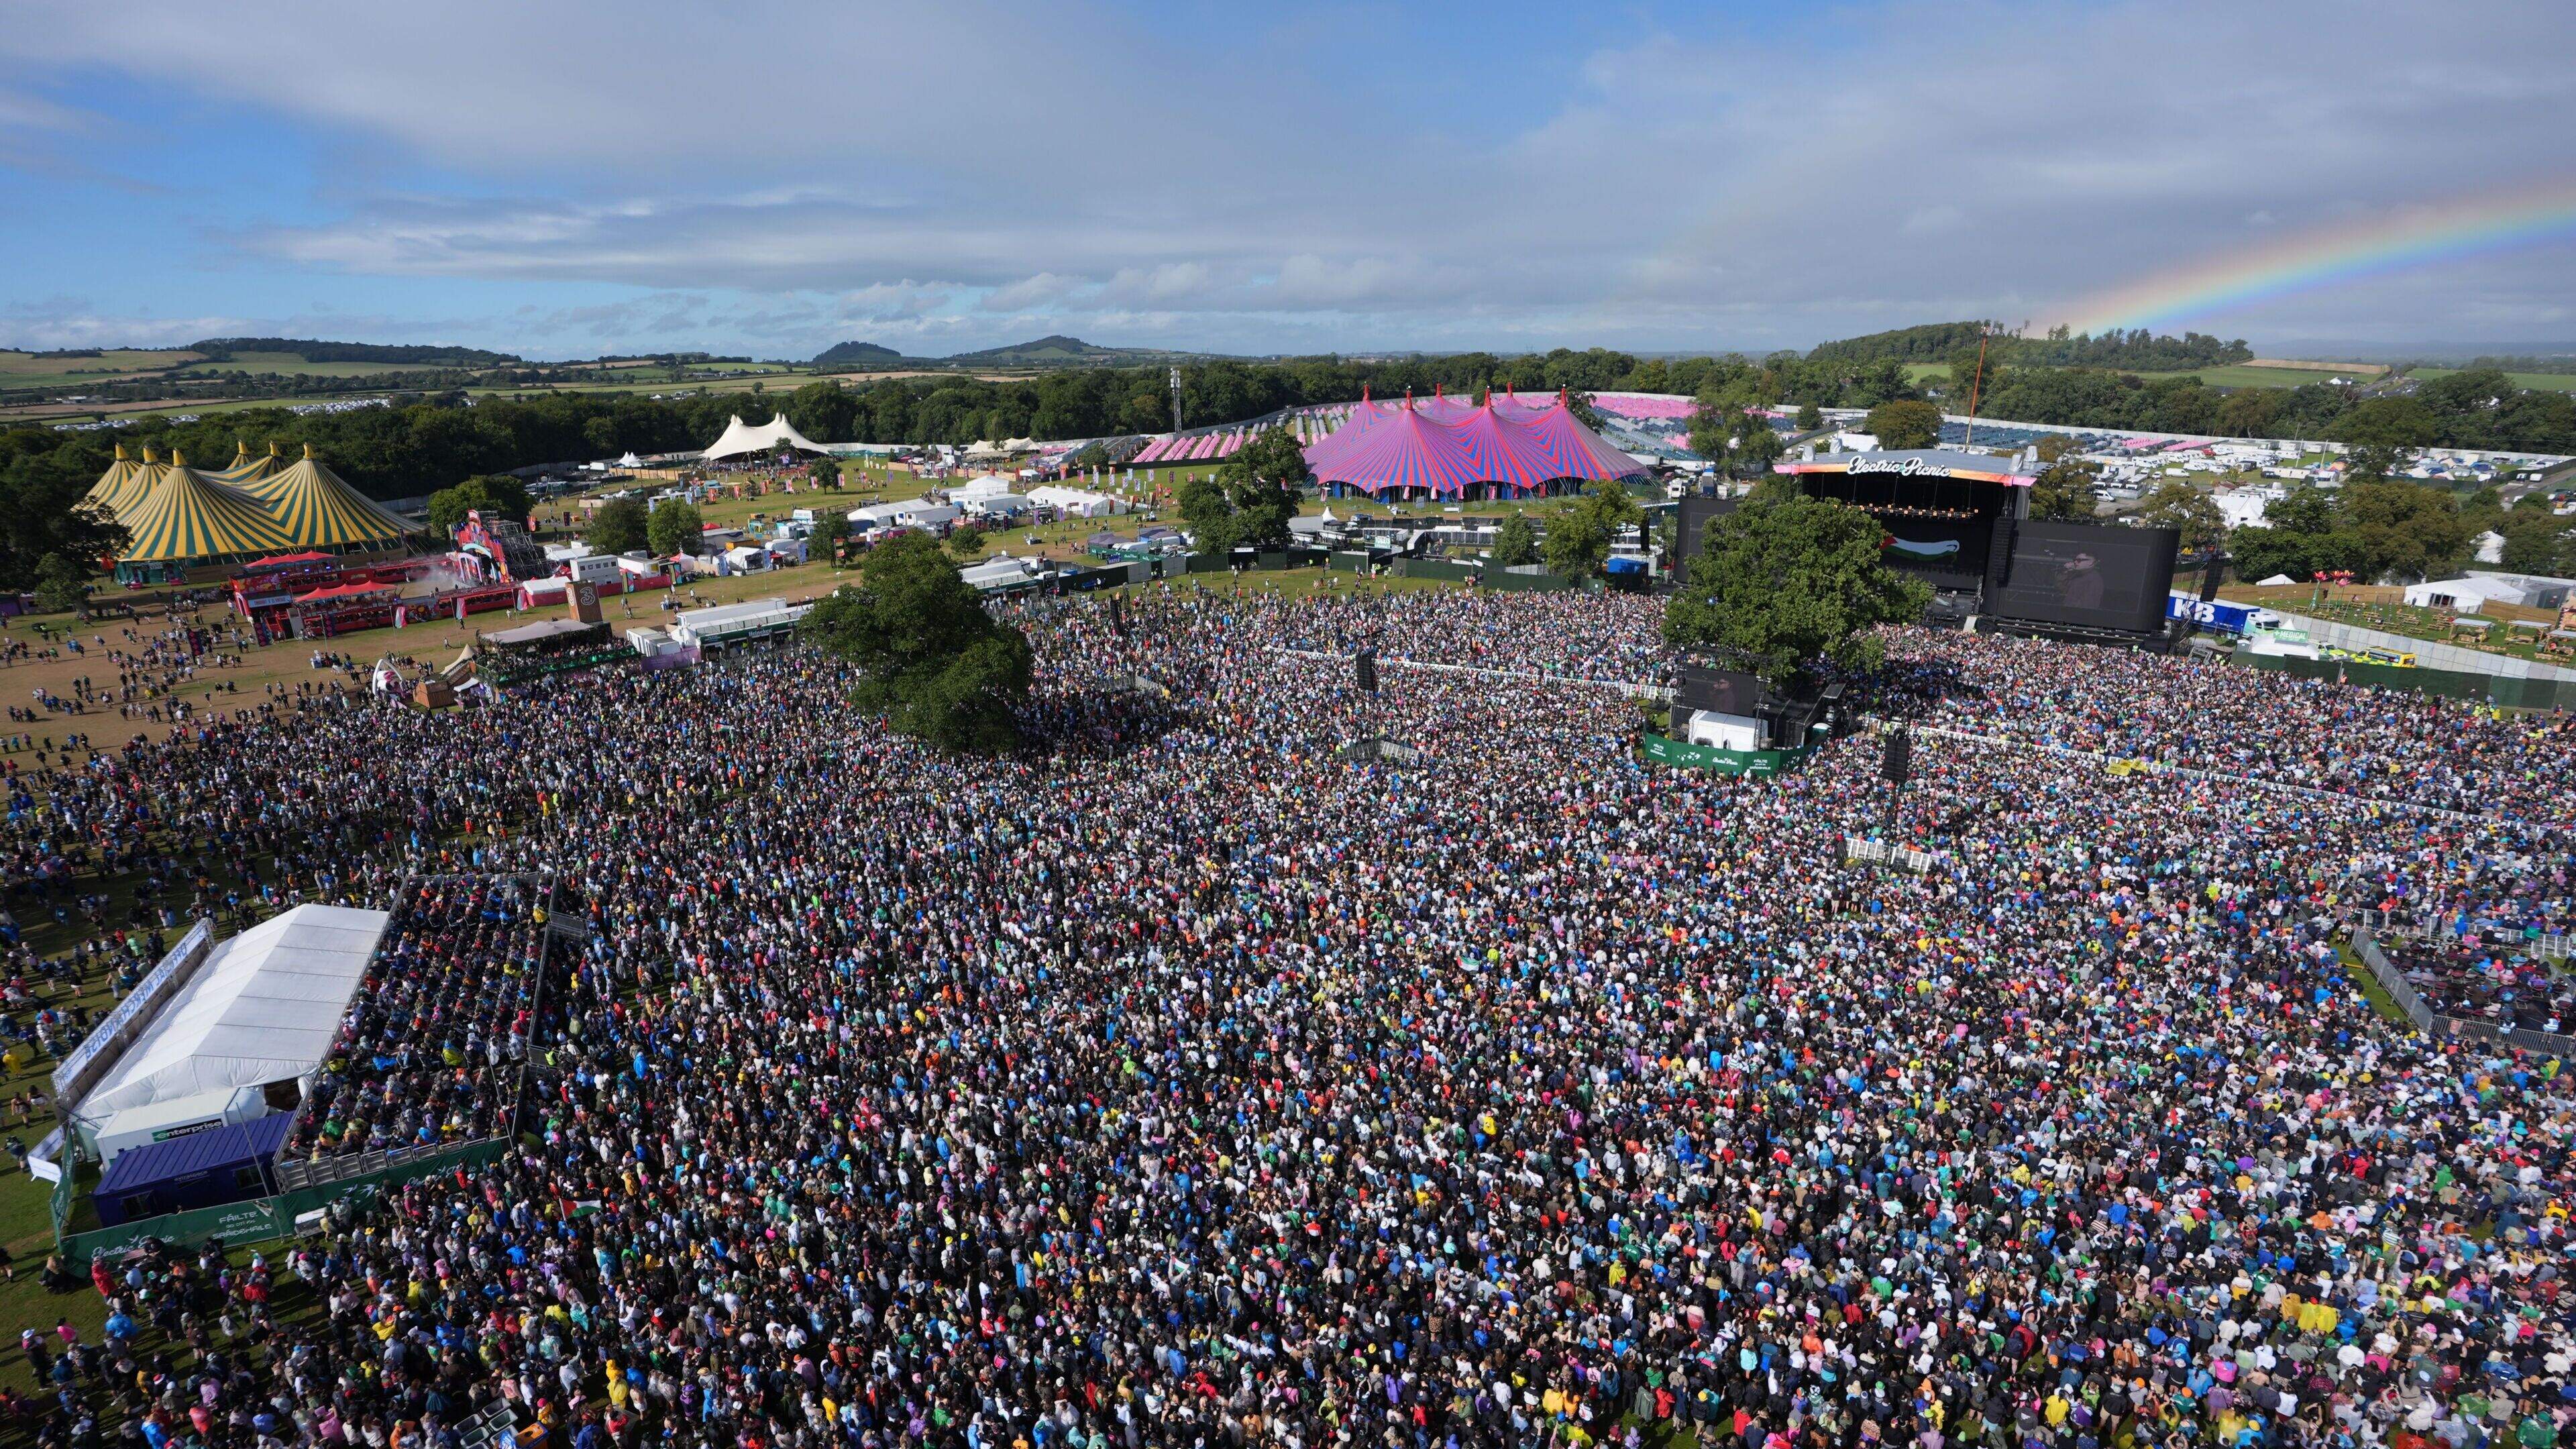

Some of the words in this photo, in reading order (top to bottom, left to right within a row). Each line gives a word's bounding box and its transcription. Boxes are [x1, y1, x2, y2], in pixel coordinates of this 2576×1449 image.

[1846, 455, 1901, 475] Electric
[1900, 457, 1951, 477] Picnic
[580, 586, 596, 606] 3
[748, 628, 772, 637] Heineken
[2279, 631, 2306, 640] MEDICAL
[154, 1120, 222, 1140] enterprise
[219, 1211, 258, 1224] FÁILTE
